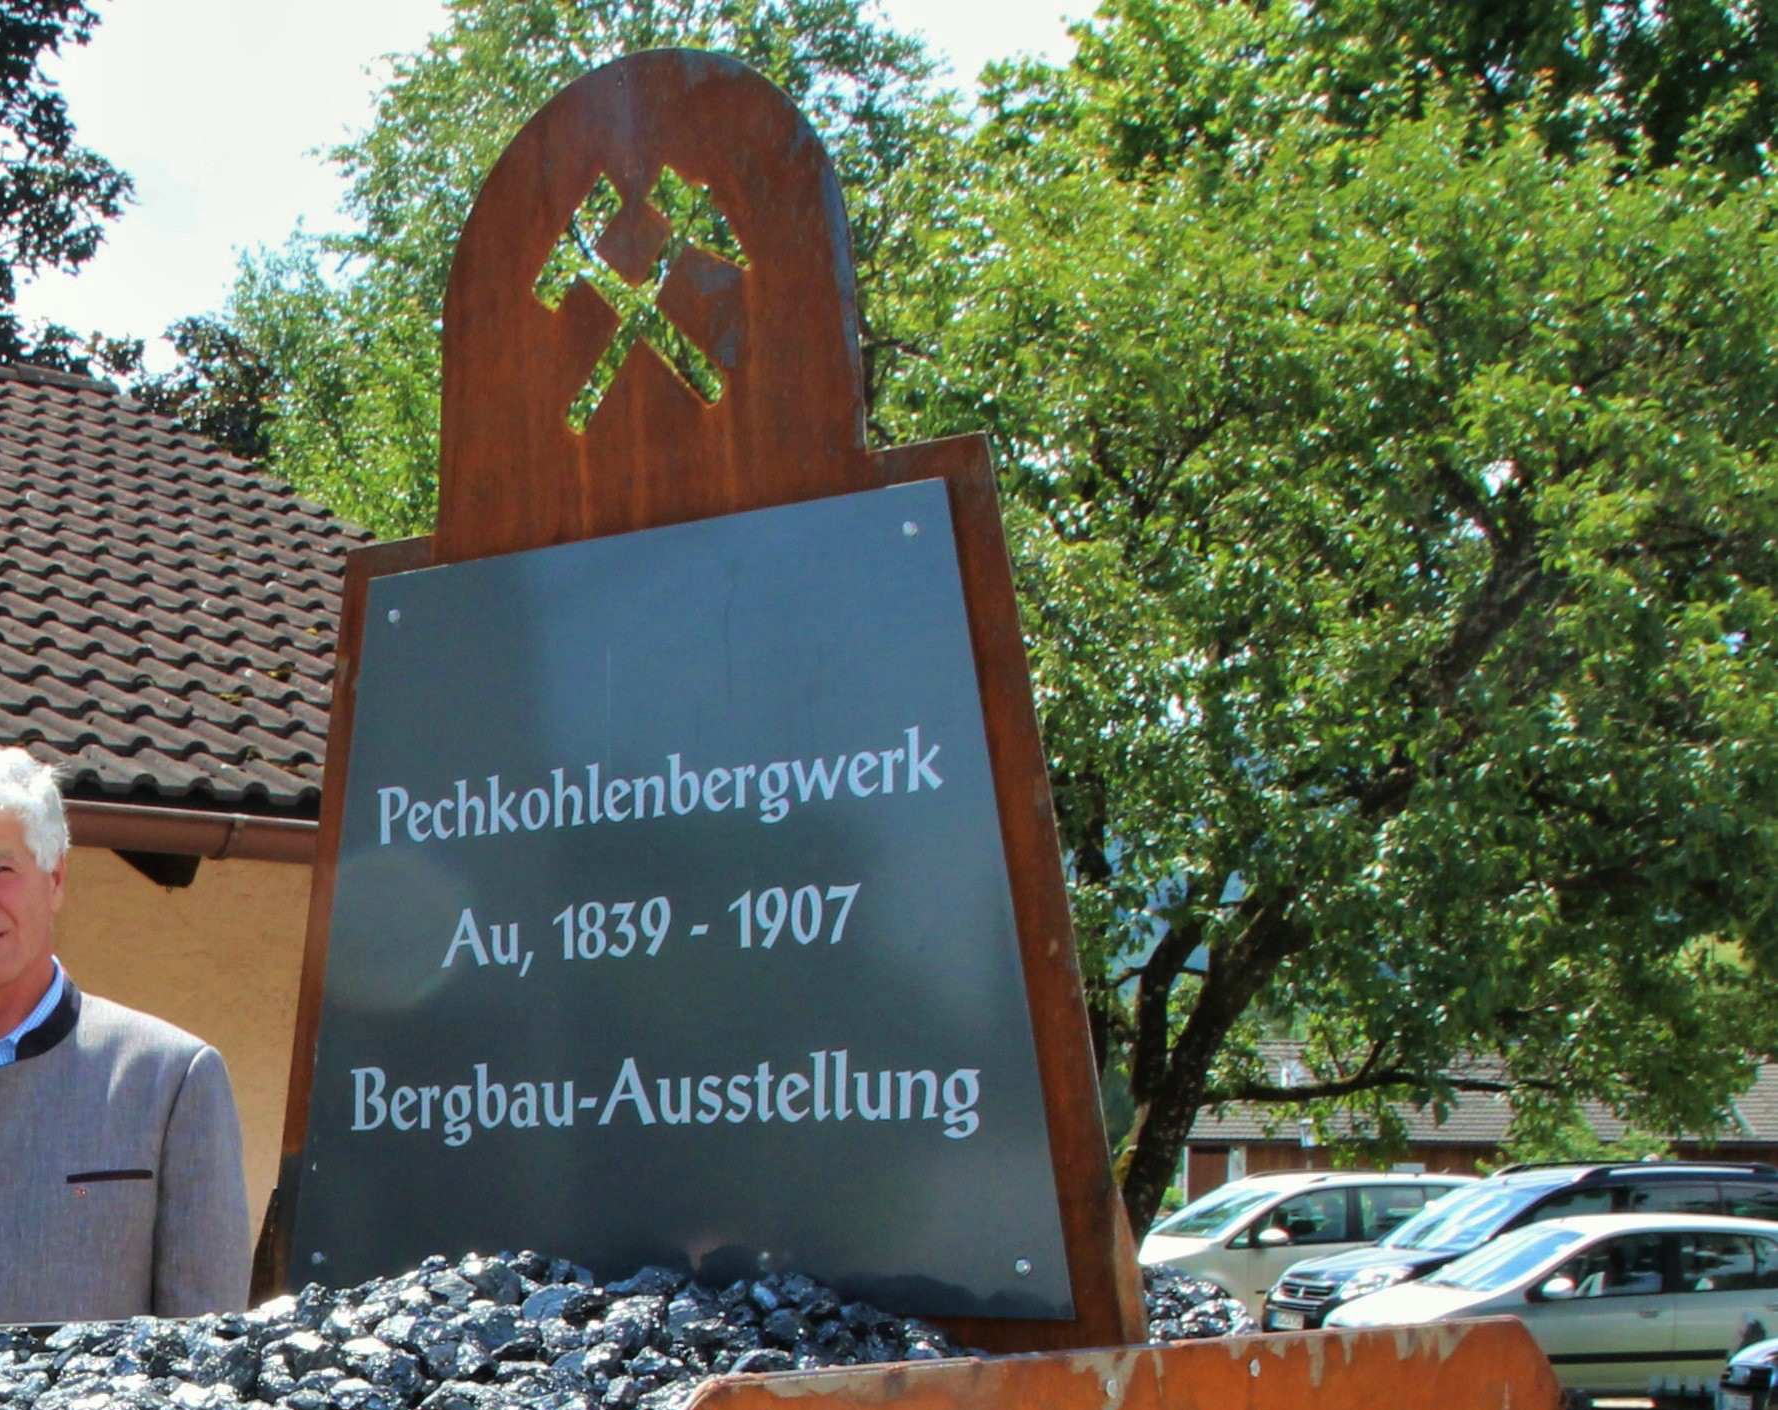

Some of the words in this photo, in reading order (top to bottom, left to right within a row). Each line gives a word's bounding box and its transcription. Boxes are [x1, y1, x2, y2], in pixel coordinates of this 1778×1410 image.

[377, 725, 944, 845] Pechkohlenbergwerk
[442, 908, 534, 978] Au,
[552, 896, 672, 960] 1839
[690, 922, 710, 937] -
[728, 882, 861, 950] 1907
[350, 1048, 982, 1147] Bergbau-Ausstellung
